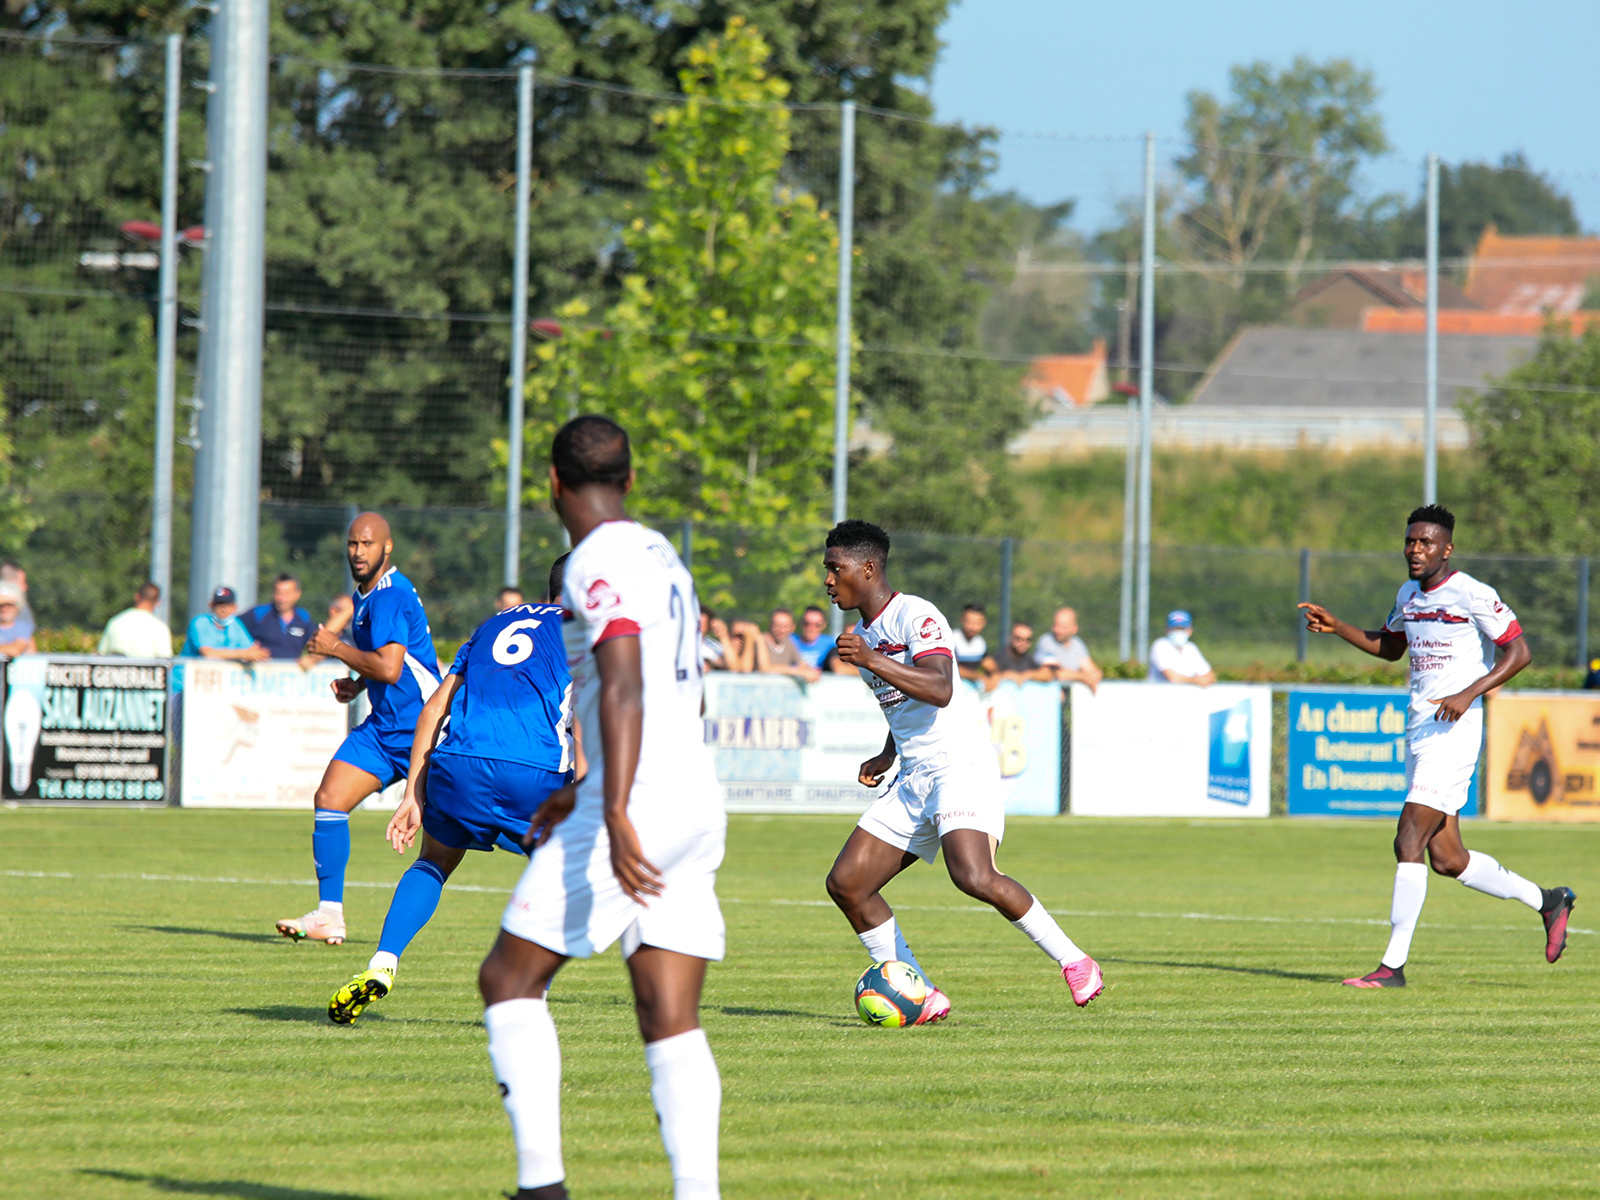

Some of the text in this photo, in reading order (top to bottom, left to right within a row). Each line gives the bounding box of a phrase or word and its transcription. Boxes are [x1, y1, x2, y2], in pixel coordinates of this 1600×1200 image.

[492, 618, 542, 665] 6
[92, 665, 166, 689] GENERALE
[42, 687, 167, 731] SARL AUZANNET
[1296, 701, 1405, 734] Au chant du
[1315, 735, 1393, 762] Restaurant
[941, 810, 977, 820] VEOLIA
